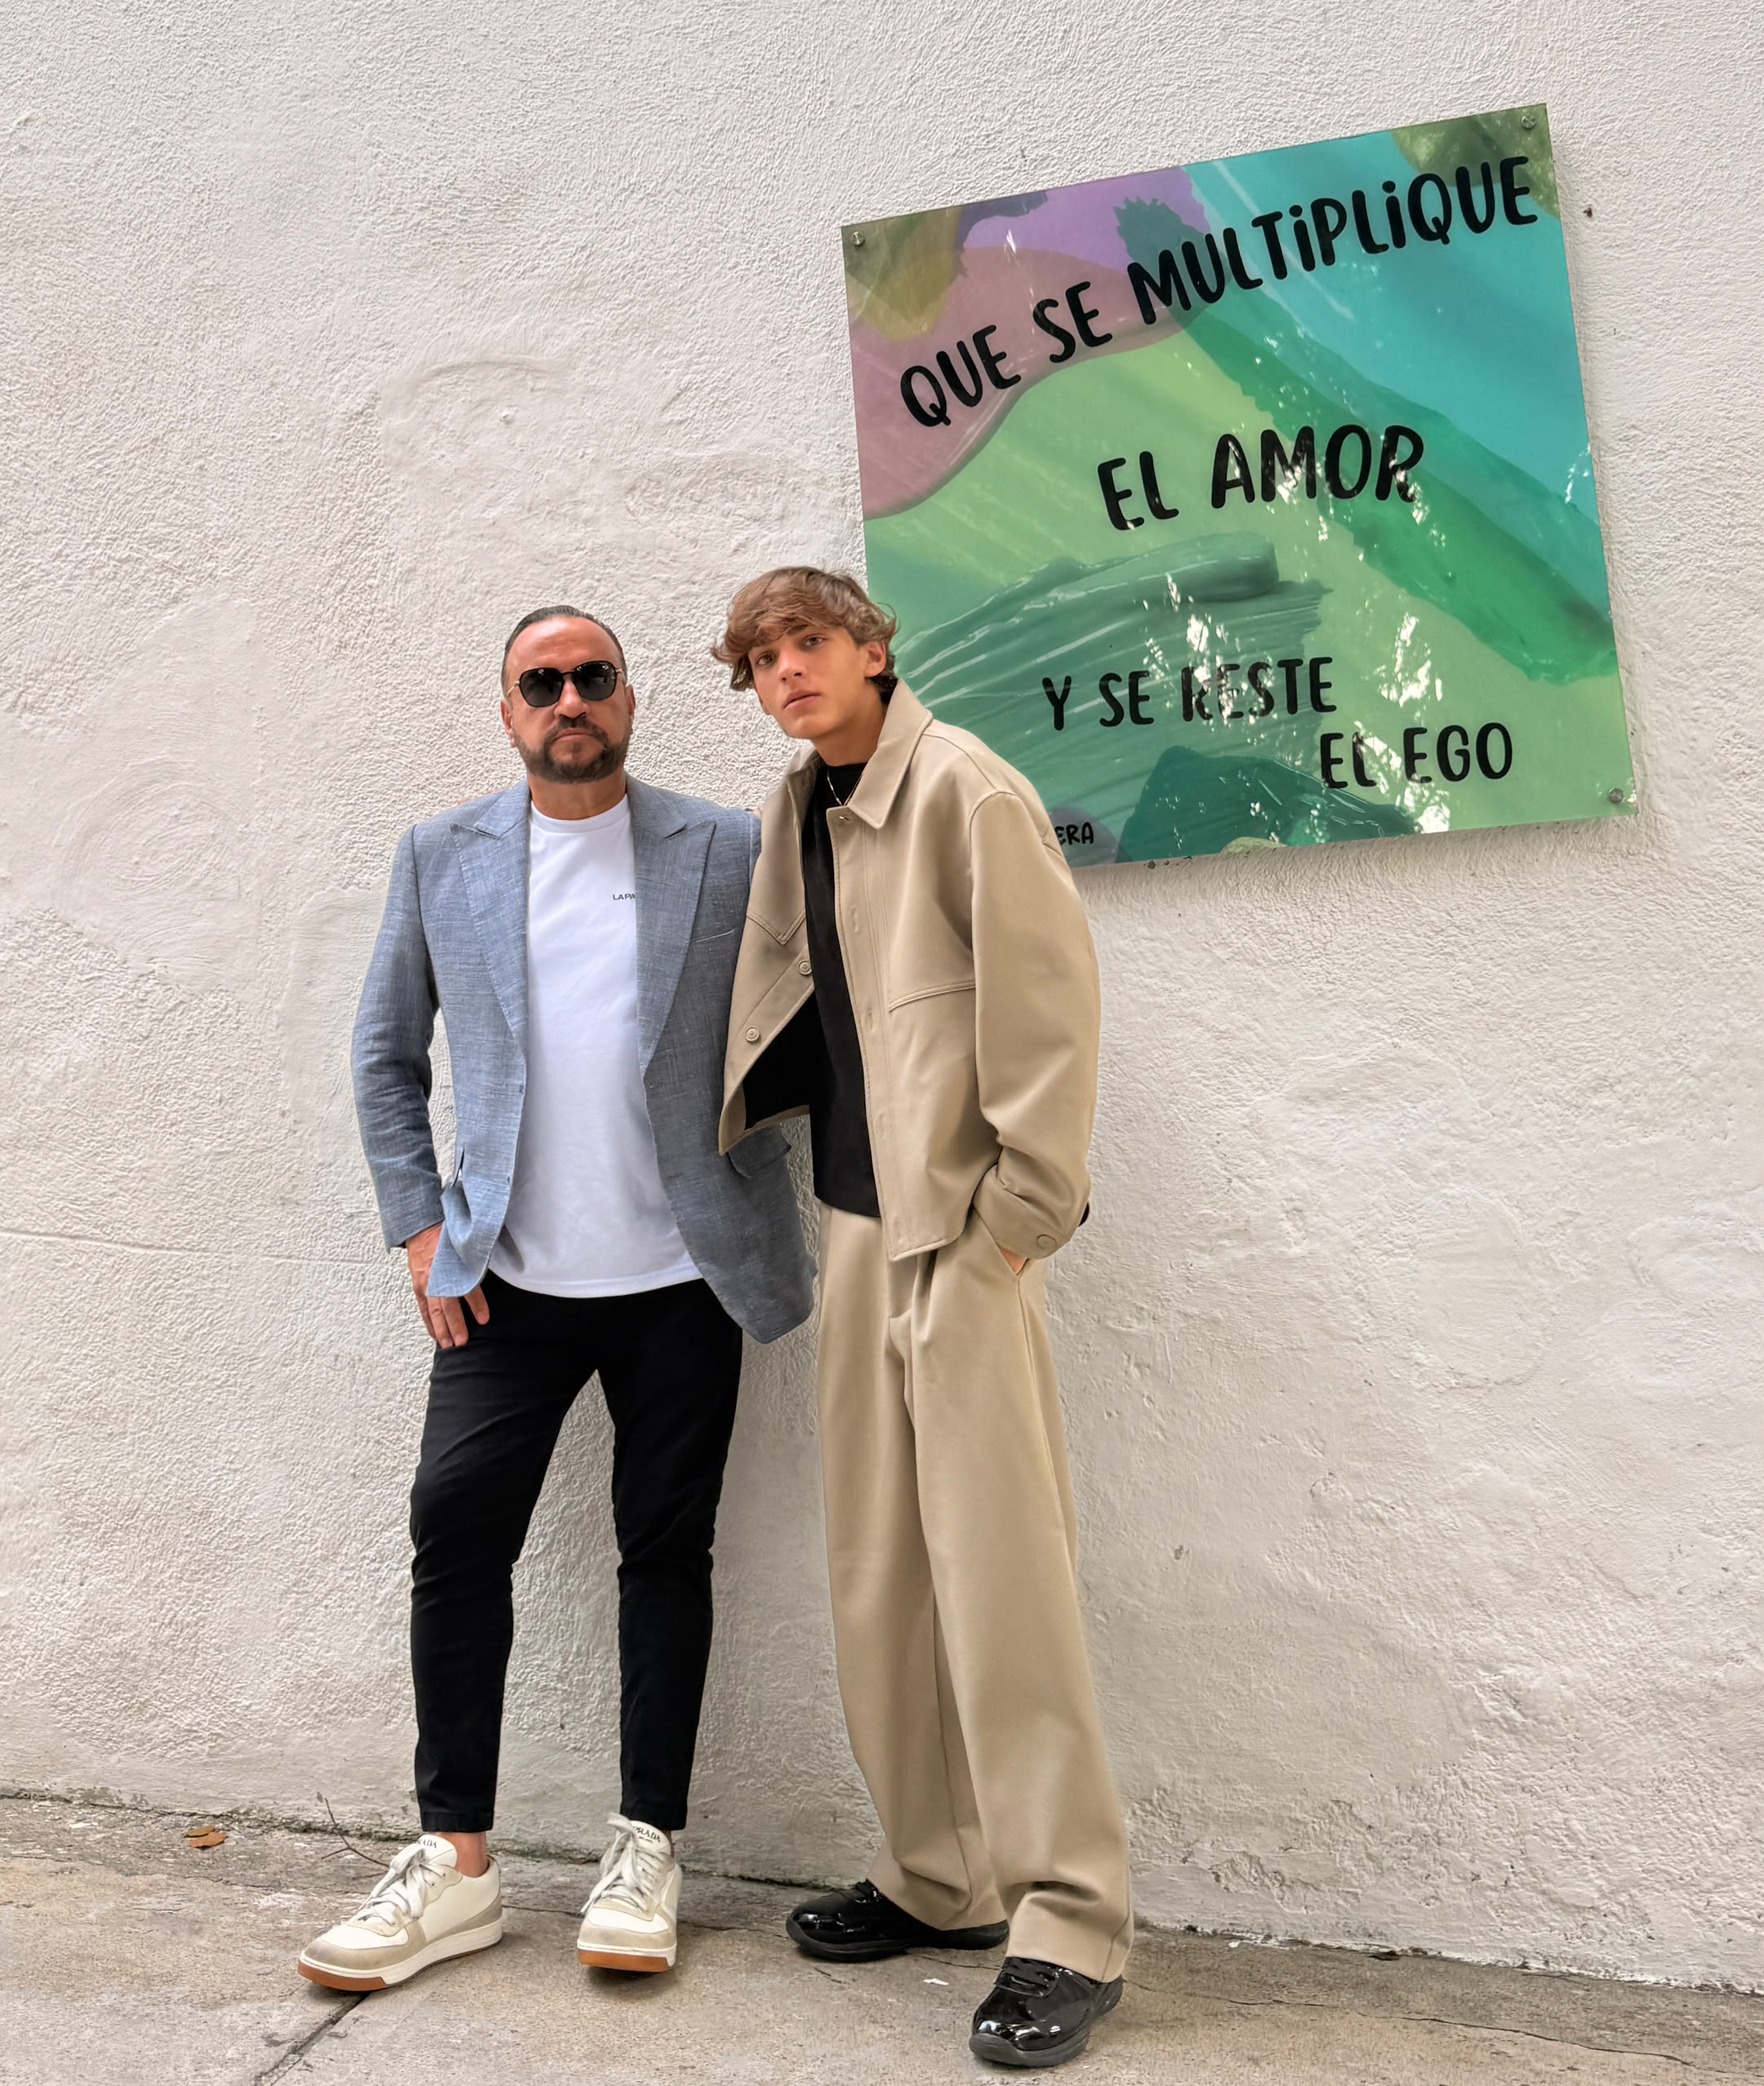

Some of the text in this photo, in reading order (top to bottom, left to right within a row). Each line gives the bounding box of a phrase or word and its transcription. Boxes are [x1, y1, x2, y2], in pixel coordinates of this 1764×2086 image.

[900, 324, 1022, 428] QUE
[1032, 281, 1113, 363] SE
[1097, 424, 1424, 530] EL AMOR
[1041, 657, 1338, 732] Y SE RESTE
[1320, 722, 1513, 790] EL EGO
